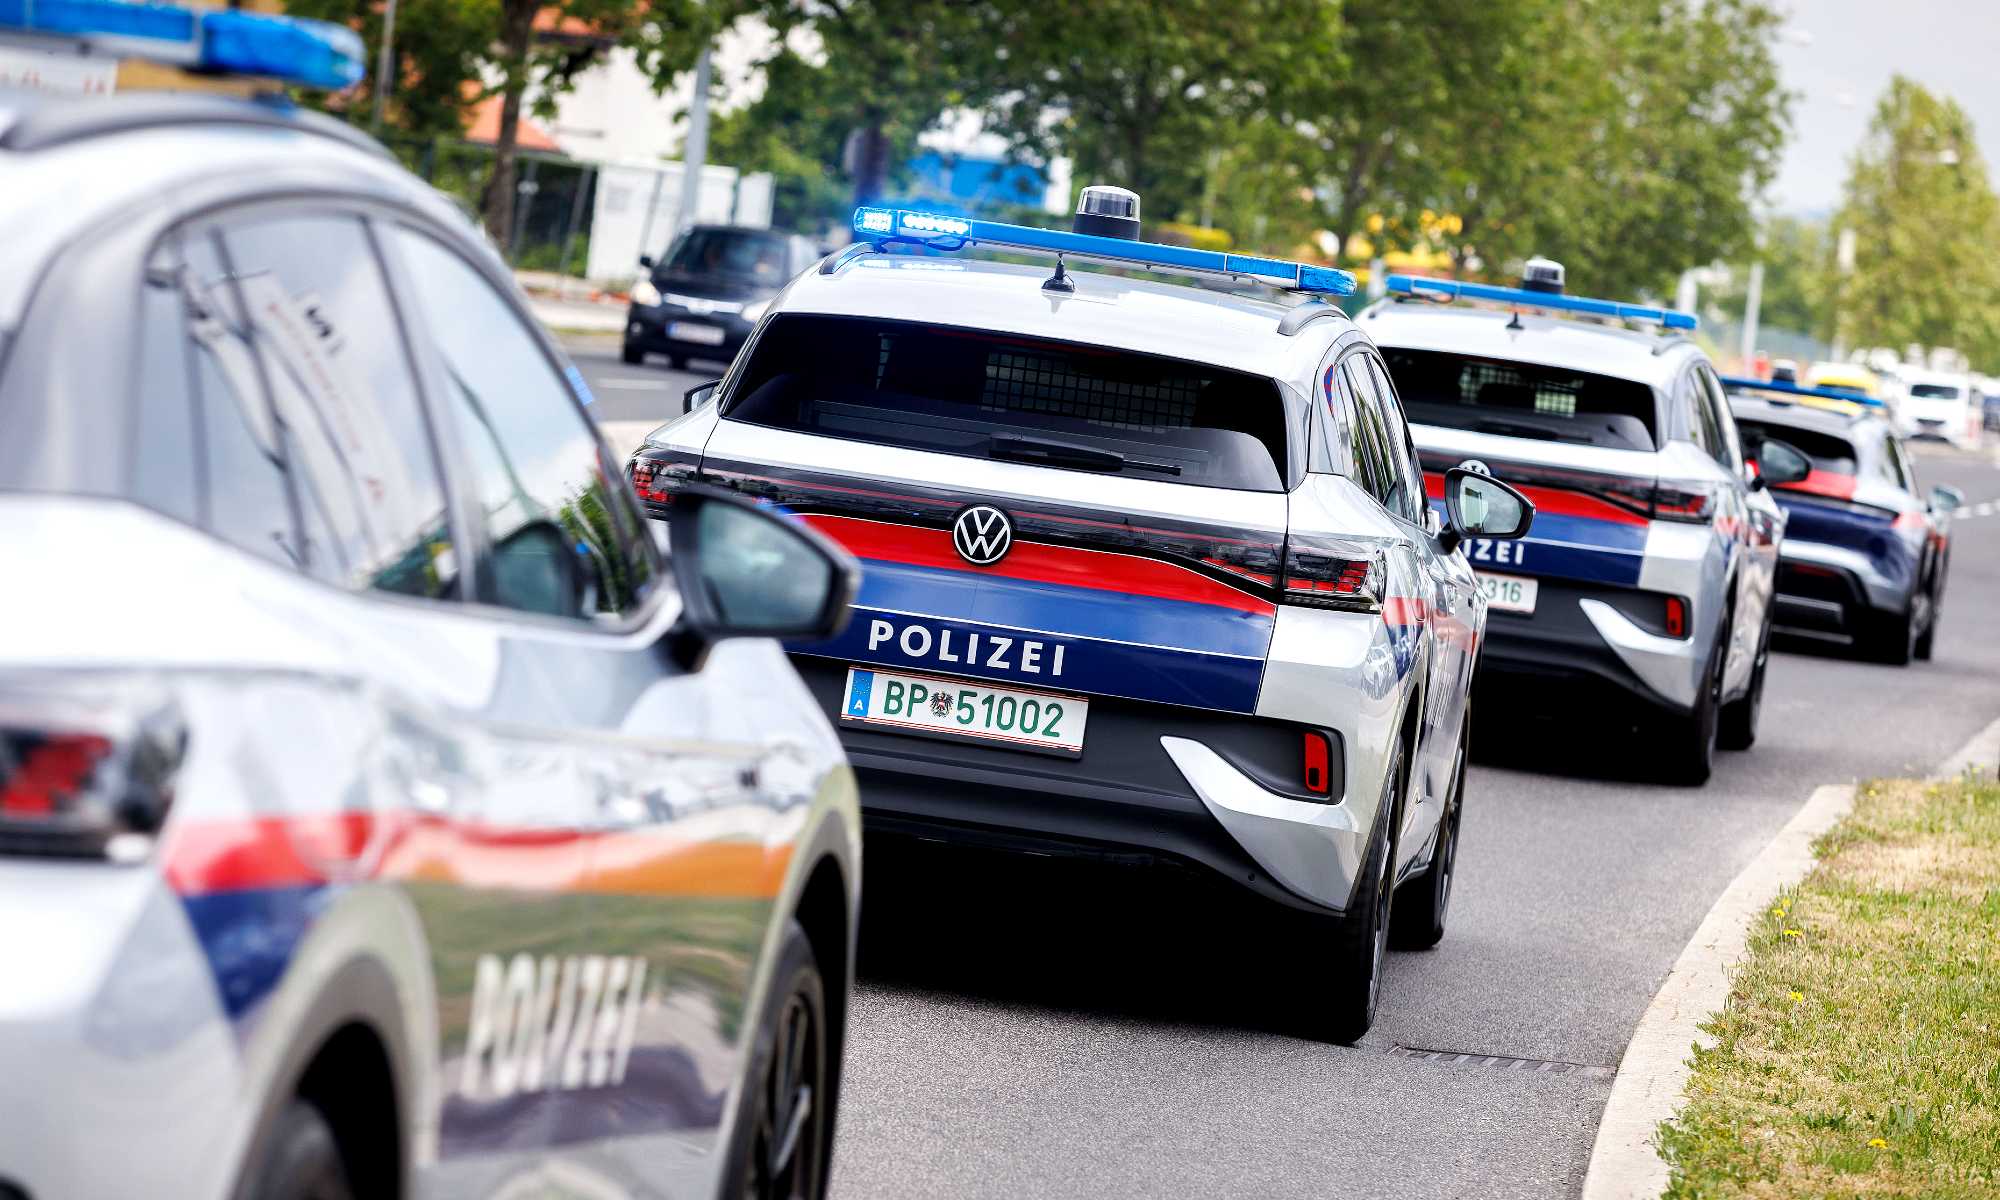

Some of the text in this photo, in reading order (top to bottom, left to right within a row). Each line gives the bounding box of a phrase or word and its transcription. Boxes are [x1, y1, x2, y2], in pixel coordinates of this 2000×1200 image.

[955, 507, 1010, 563] VW
[1463, 539, 1524, 565] IZEI
[1478, 577, 1522, 603] 316
[868, 619, 1065, 676] POLIZEI
[853, 699, 864, 711] A
[883, 680, 1064, 738] BP 51002
[459, 952, 648, 1098] POLIZEI
